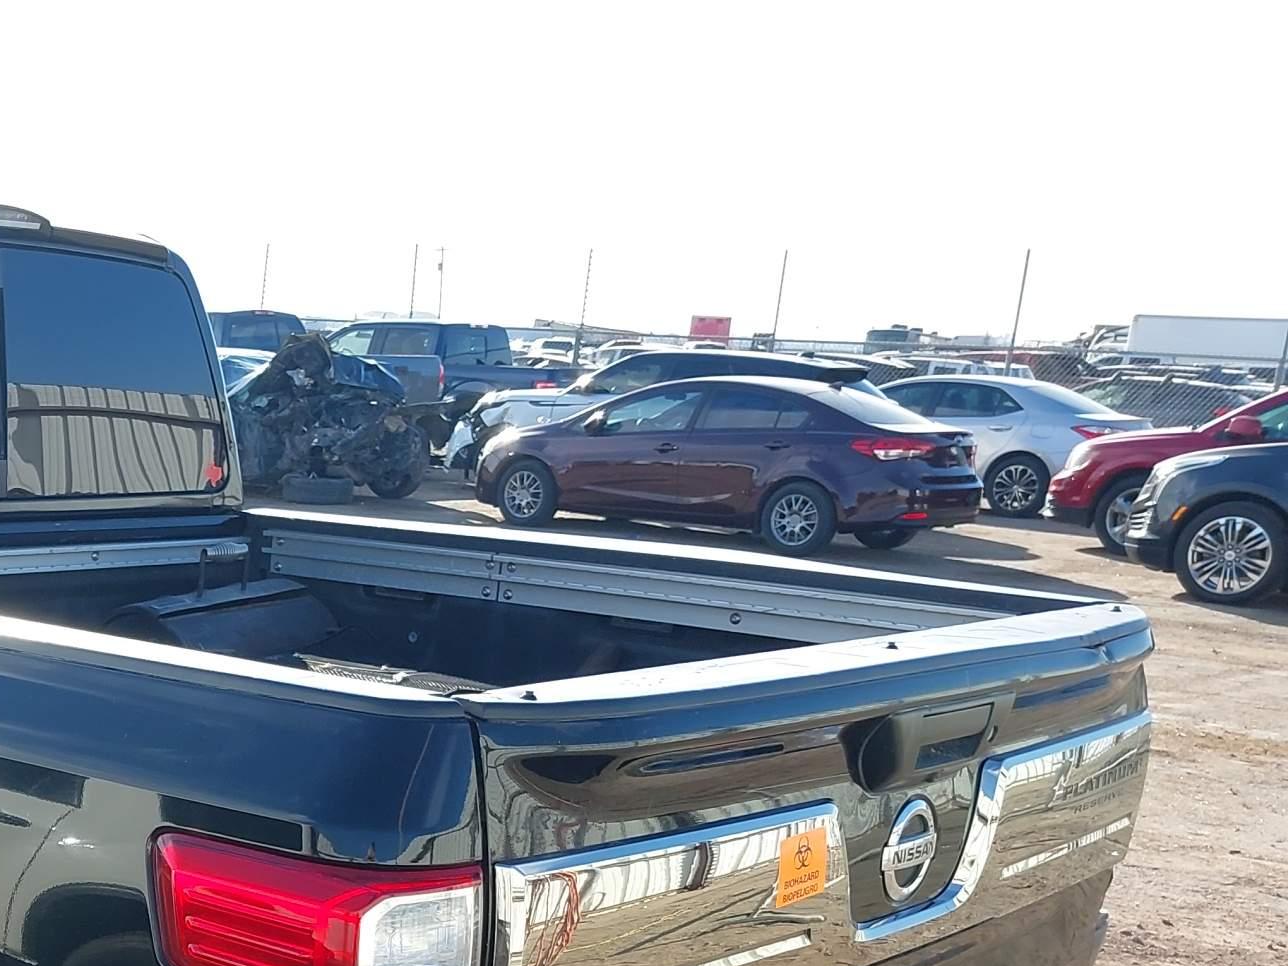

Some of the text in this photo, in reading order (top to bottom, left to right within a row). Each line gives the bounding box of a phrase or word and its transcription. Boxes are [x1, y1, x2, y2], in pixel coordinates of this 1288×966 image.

[1062, 758, 1140, 801] PLATINUM
[892, 841, 934, 865] NISSAN
[783, 870, 820, 890] BIOHAZARD
[782, 884, 819, 903] BIOPELIGRO
